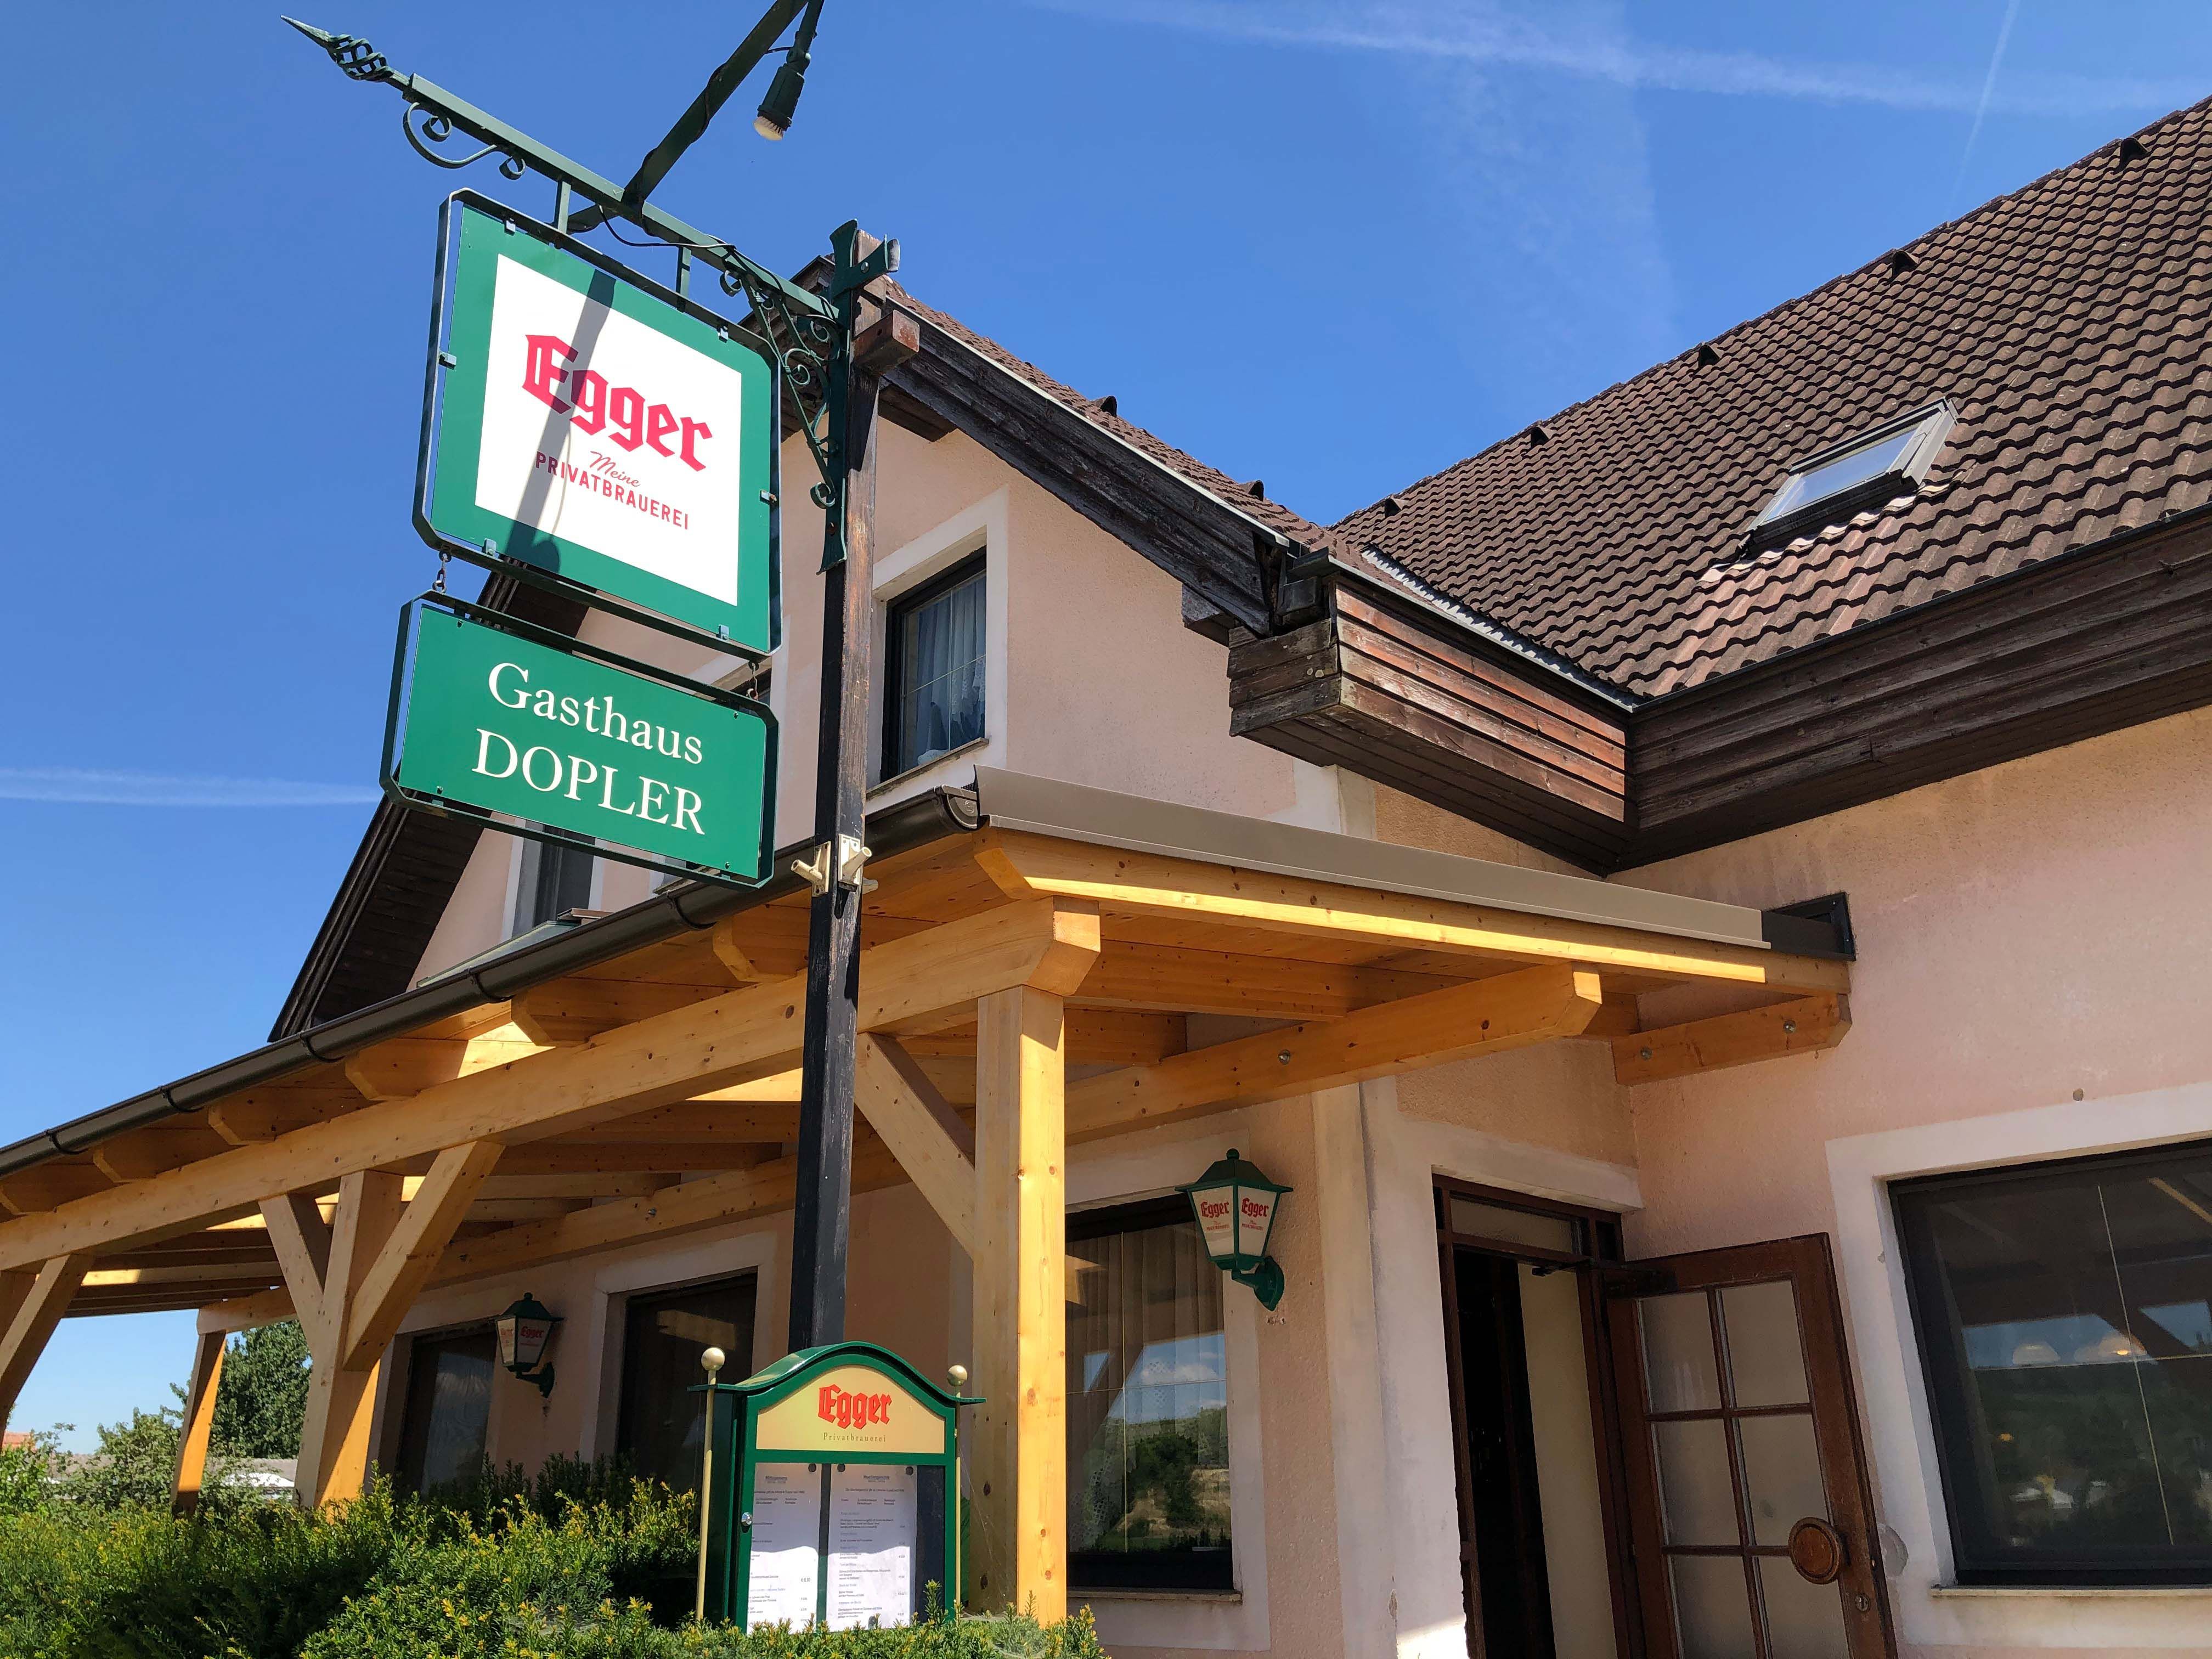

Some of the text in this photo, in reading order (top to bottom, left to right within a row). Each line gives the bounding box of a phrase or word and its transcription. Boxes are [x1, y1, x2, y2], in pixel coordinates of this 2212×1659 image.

[522, 334, 713, 472] Egger
[535, 451, 688, 530] PRIVATBRAUEREI
[589, 450, 641, 487] Meine
[488, 663, 702, 764] Gasthaus
[472, 728, 705, 835] DOPLER
[1200, 1201, 1229, 1218] Egger
[1241, 1198, 1269, 1217] Egger
[818, 1384, 892, 1430] Egger
[823, 1432, 886, 1442] Privatbrauerei
